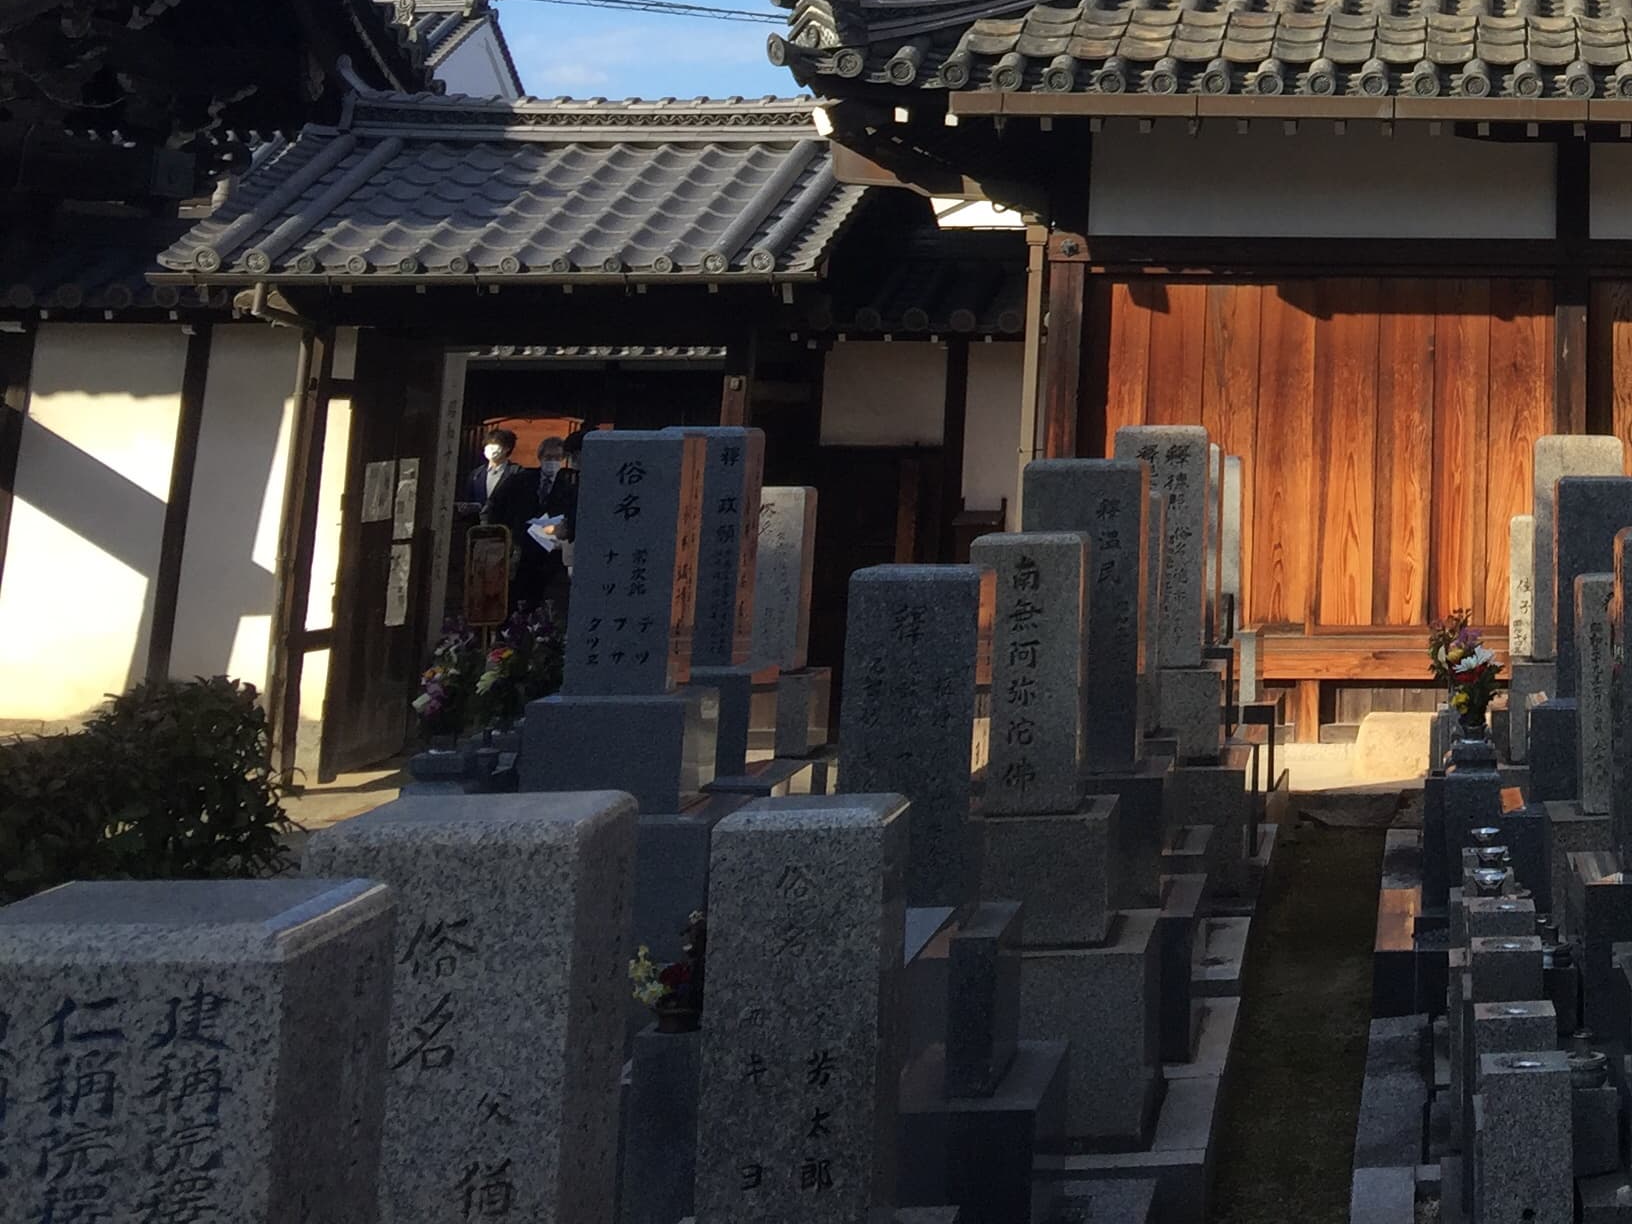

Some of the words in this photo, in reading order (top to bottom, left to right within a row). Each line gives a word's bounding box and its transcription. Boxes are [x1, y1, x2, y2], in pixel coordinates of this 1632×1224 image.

[612, 459, 648, 521] 俗名
[1002, 555, 1044, 794] 南無阿弥陀佛
[390, 917, 478, 1071] 俗名
